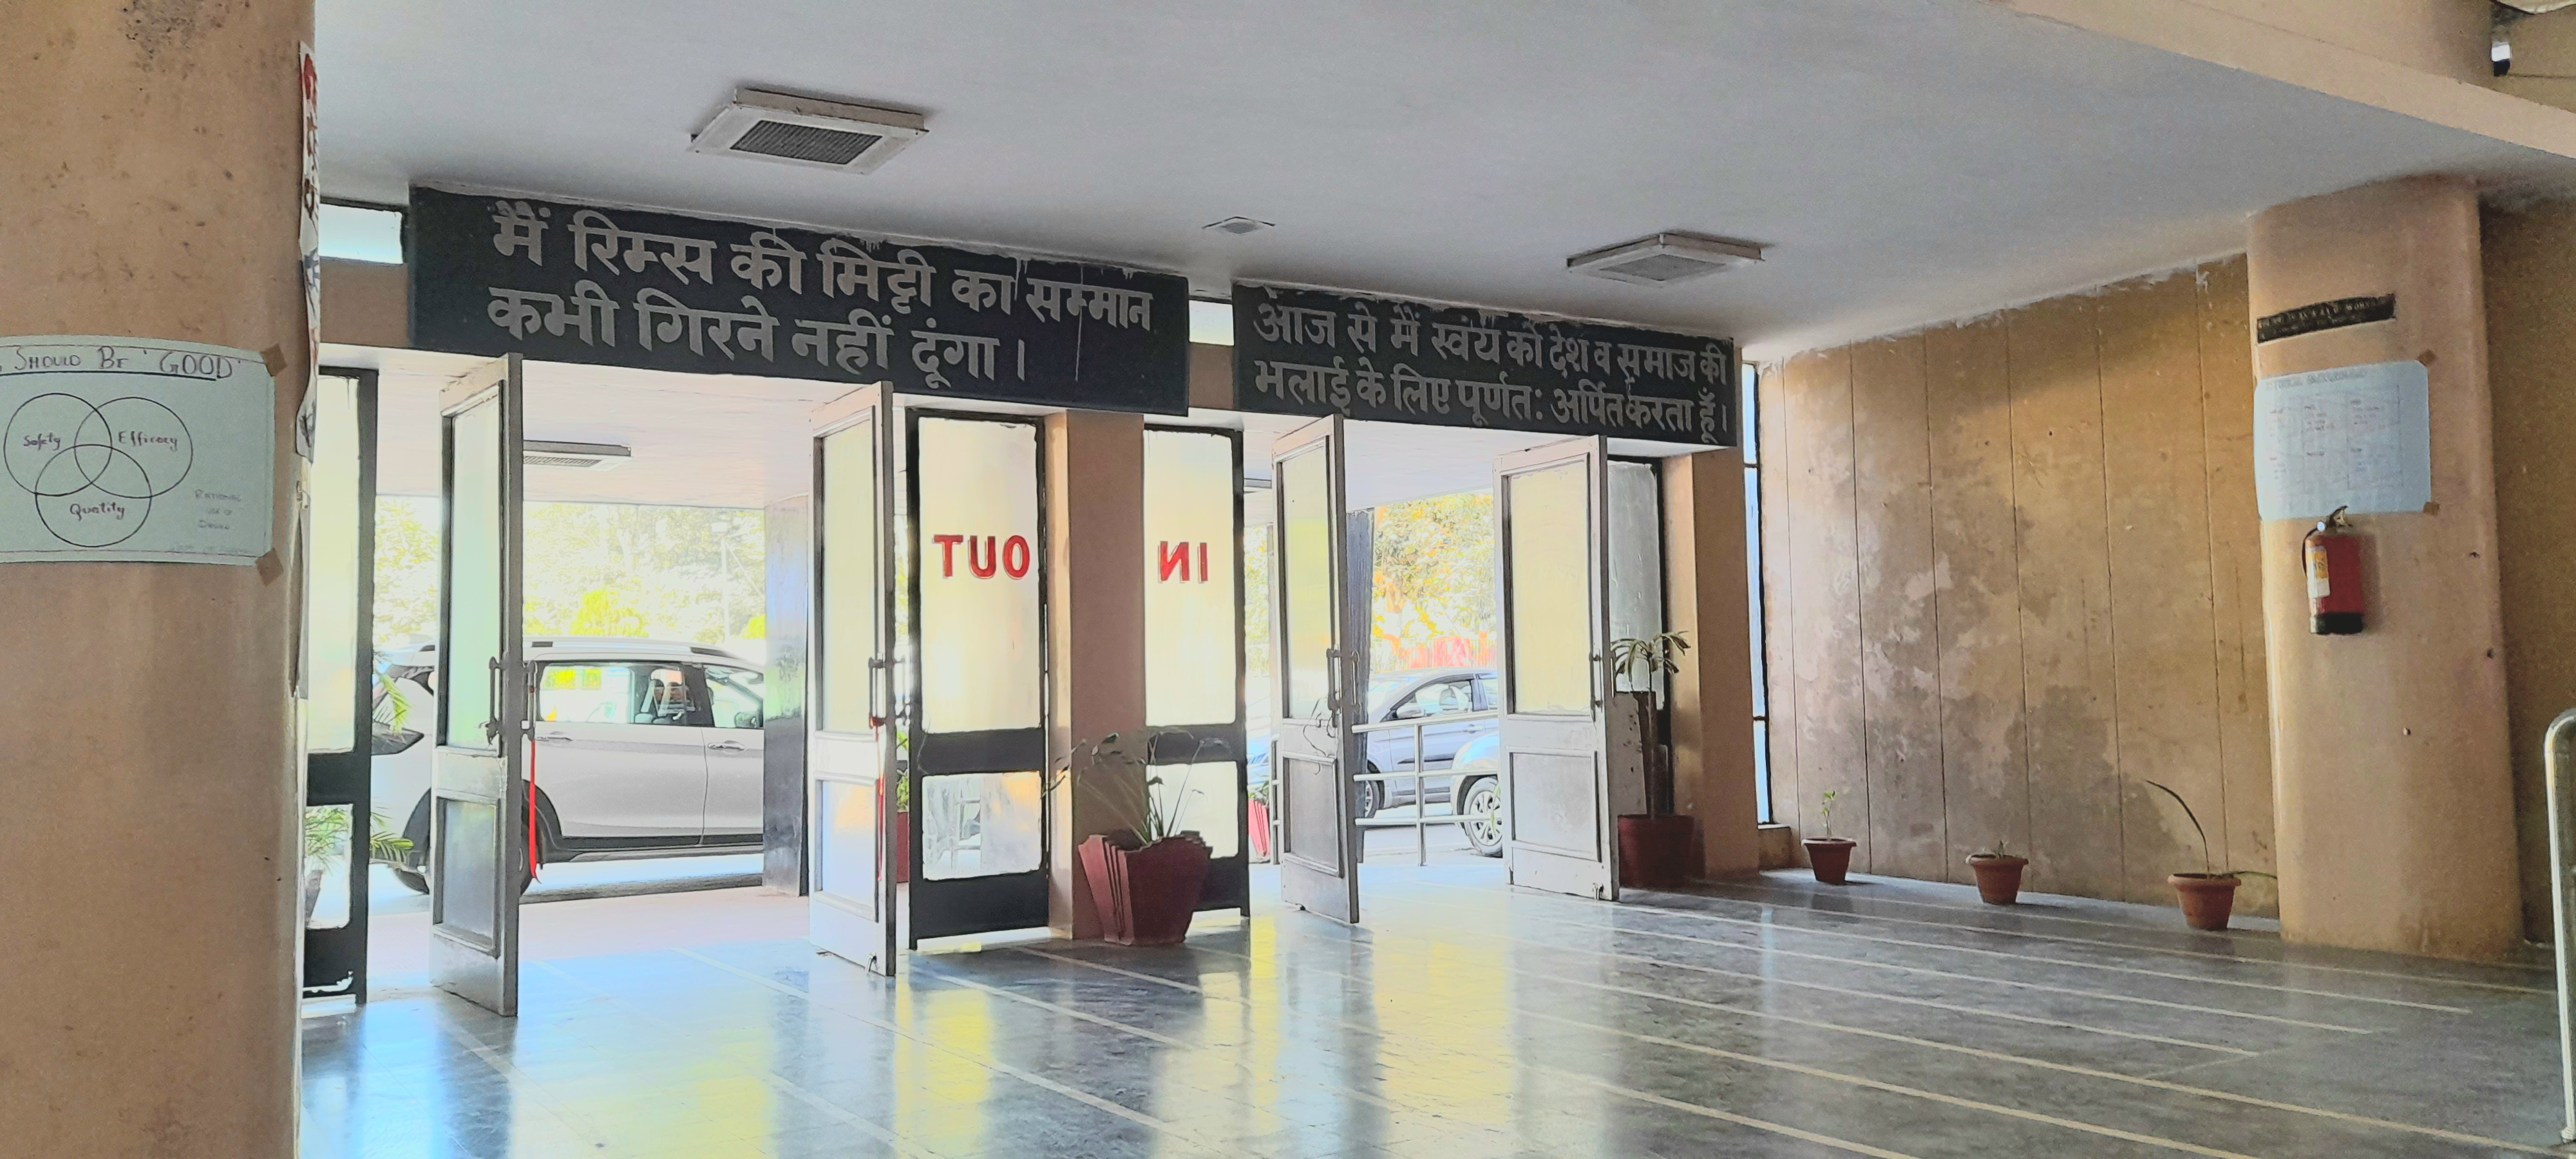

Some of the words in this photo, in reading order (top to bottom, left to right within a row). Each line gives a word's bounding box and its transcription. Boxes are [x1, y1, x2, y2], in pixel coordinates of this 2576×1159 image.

[492, 200, 552, 266] मैं
[568, 210, 717, 285] रिम्स
[730, 232, 806, 294] की
[817, 238, 936, 314] मिट्टी
[951, 269, 1015, 315] का
[1027, 278, 1153, 330] सम्मान
[488, 279, 620, 347] कभी
[633, 287, 779, 361] गिरने
[792, 308, 895, 375] नहीं
[1253, 303, 1336, 348] आज
[1347, 301, 1377, 353] से
[1507, 321, 1544, 369] को
[1549, 323, 1589, 379] देश
[1594, 341, 1612, 376] व
[1617, 343, 1696, 382] समाज
[1700, 342, 1727, 386] की
[14, 348, 81, 371] SHOULD
[1254, 355, 1351, 417] भलाई
[1355, 356, 1387, 408] के
[1390, 363, 1451, 415] लिए
[23, 432, 61, 451] Safety
[118, 430, 178, 452] Efficacy
[70, 502, 126, 521] Quality
